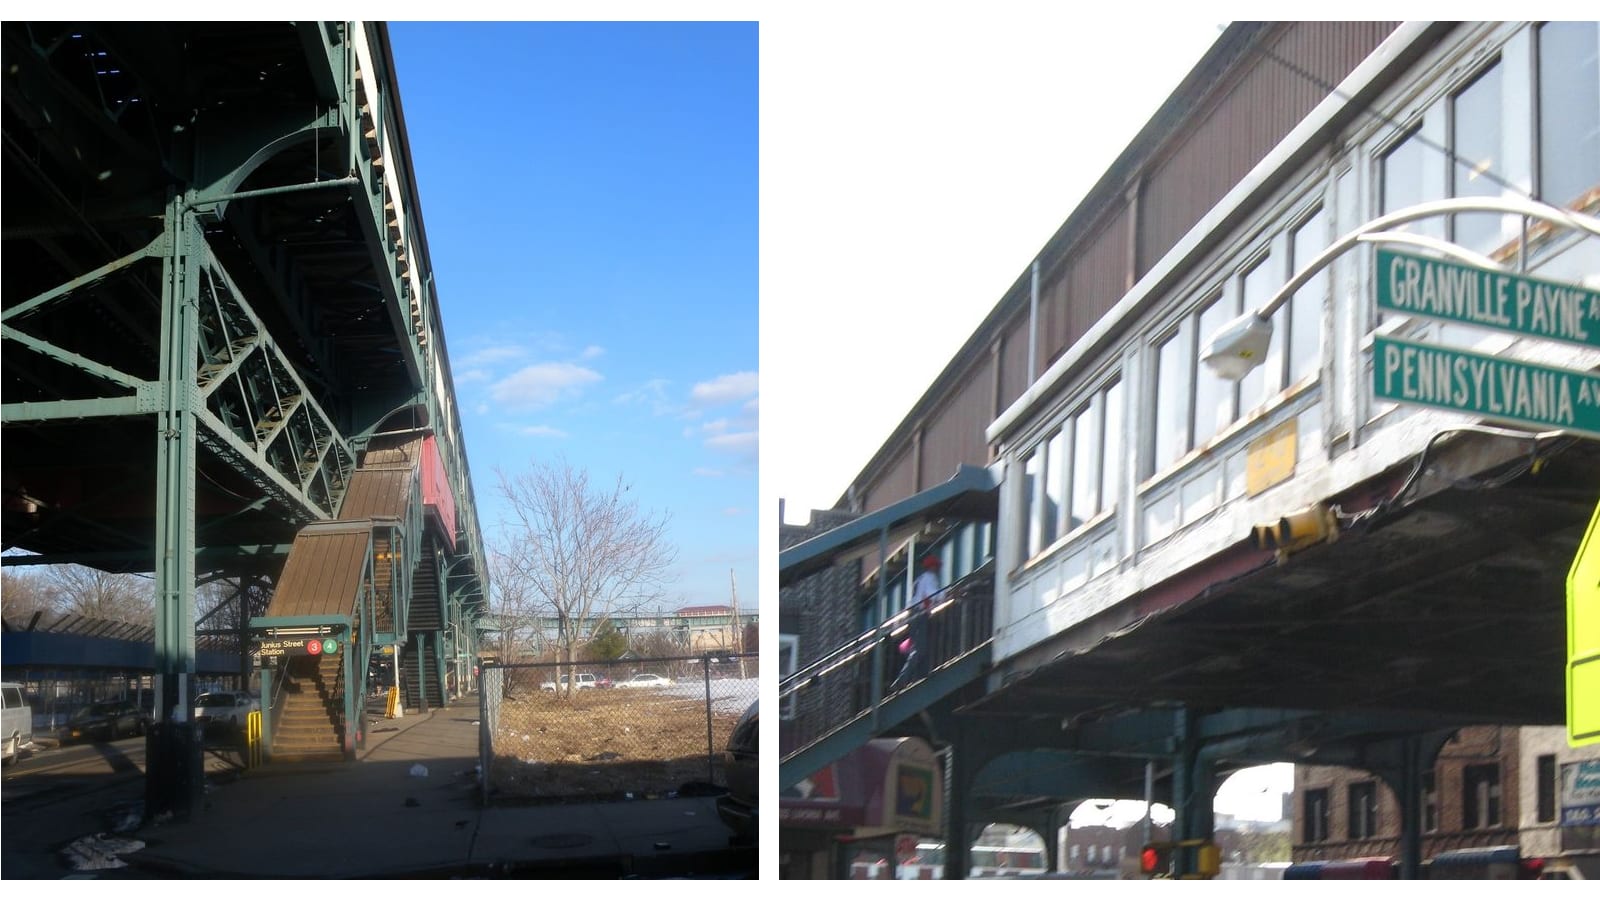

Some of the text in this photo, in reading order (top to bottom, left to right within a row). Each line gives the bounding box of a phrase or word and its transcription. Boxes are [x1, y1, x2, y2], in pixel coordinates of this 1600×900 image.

[1390, 256, 1511, 325] GRANVILLE
[1516, 280, 1589, 341] PAYNE
[1384, 343, 1574, 425] PENNSYLVANIA
[260, 640, 333, 651] Junius Street 3 4
[260, 648, 285, 656] Station
